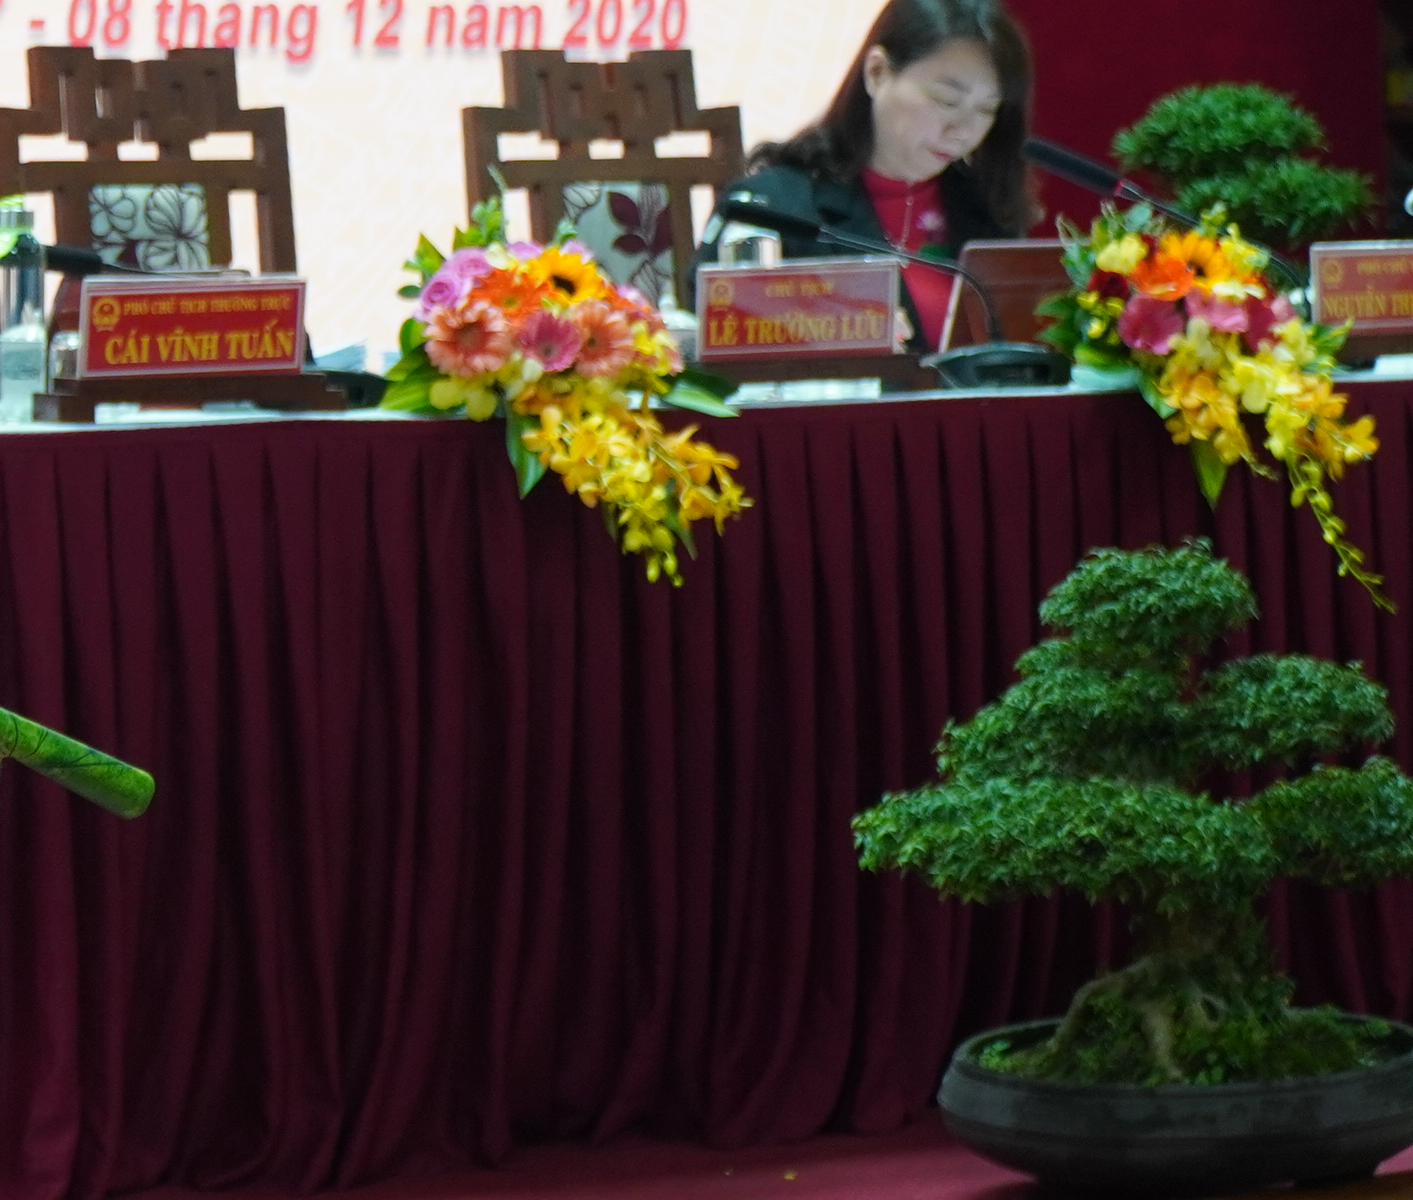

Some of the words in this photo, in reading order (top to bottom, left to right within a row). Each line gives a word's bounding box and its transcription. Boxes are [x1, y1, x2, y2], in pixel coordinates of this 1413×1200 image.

[29, 18, 44, 29] -
[104, 328, 150, 365] CÁI
[156, 327, 220, 363] VĨNH
[226, 318, 295, 360] TUẤN
[708, 315, 738, 347] LÊ
